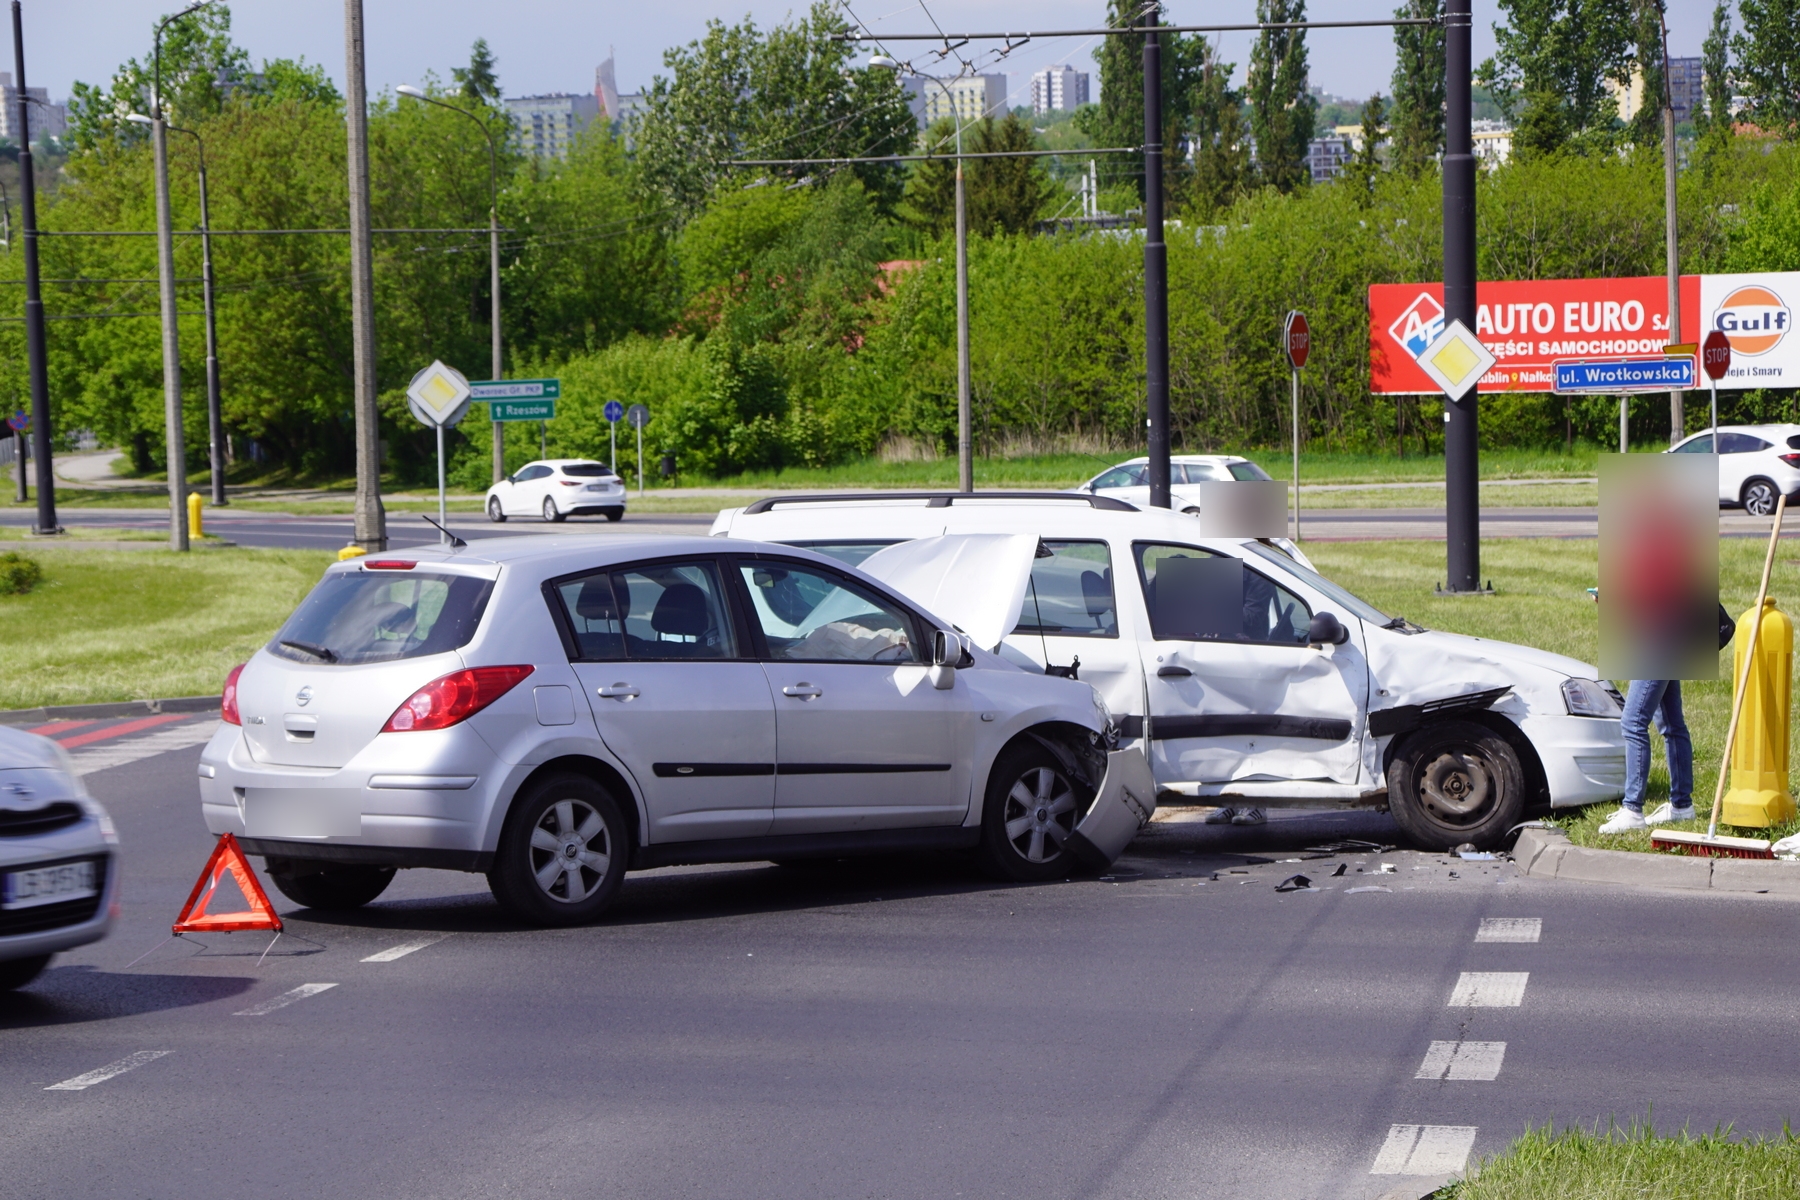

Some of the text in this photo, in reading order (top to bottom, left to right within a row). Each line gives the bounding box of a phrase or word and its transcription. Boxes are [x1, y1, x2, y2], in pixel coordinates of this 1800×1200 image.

[1476, 302, 1555, 335] AUTO
[1564, 300, 1645, 333] EURO
[1716, 311, 1787, 331] Gulf
[1291, 332, 1308, 350] STOP
[1483, 339, 1670, 358] ZĘŚCI SAMOCHODOW
[1706, 347, 1729, 364] STOP
[1478, 371, 1510, 384] ublin
[1561, 365, 1681, 384] ul. Wrotkowska
[1727, 368, 1745, 377] leje
[1752, 366, 1783, 377] Smary
[506, 404, 549, 415] Rzeszów
